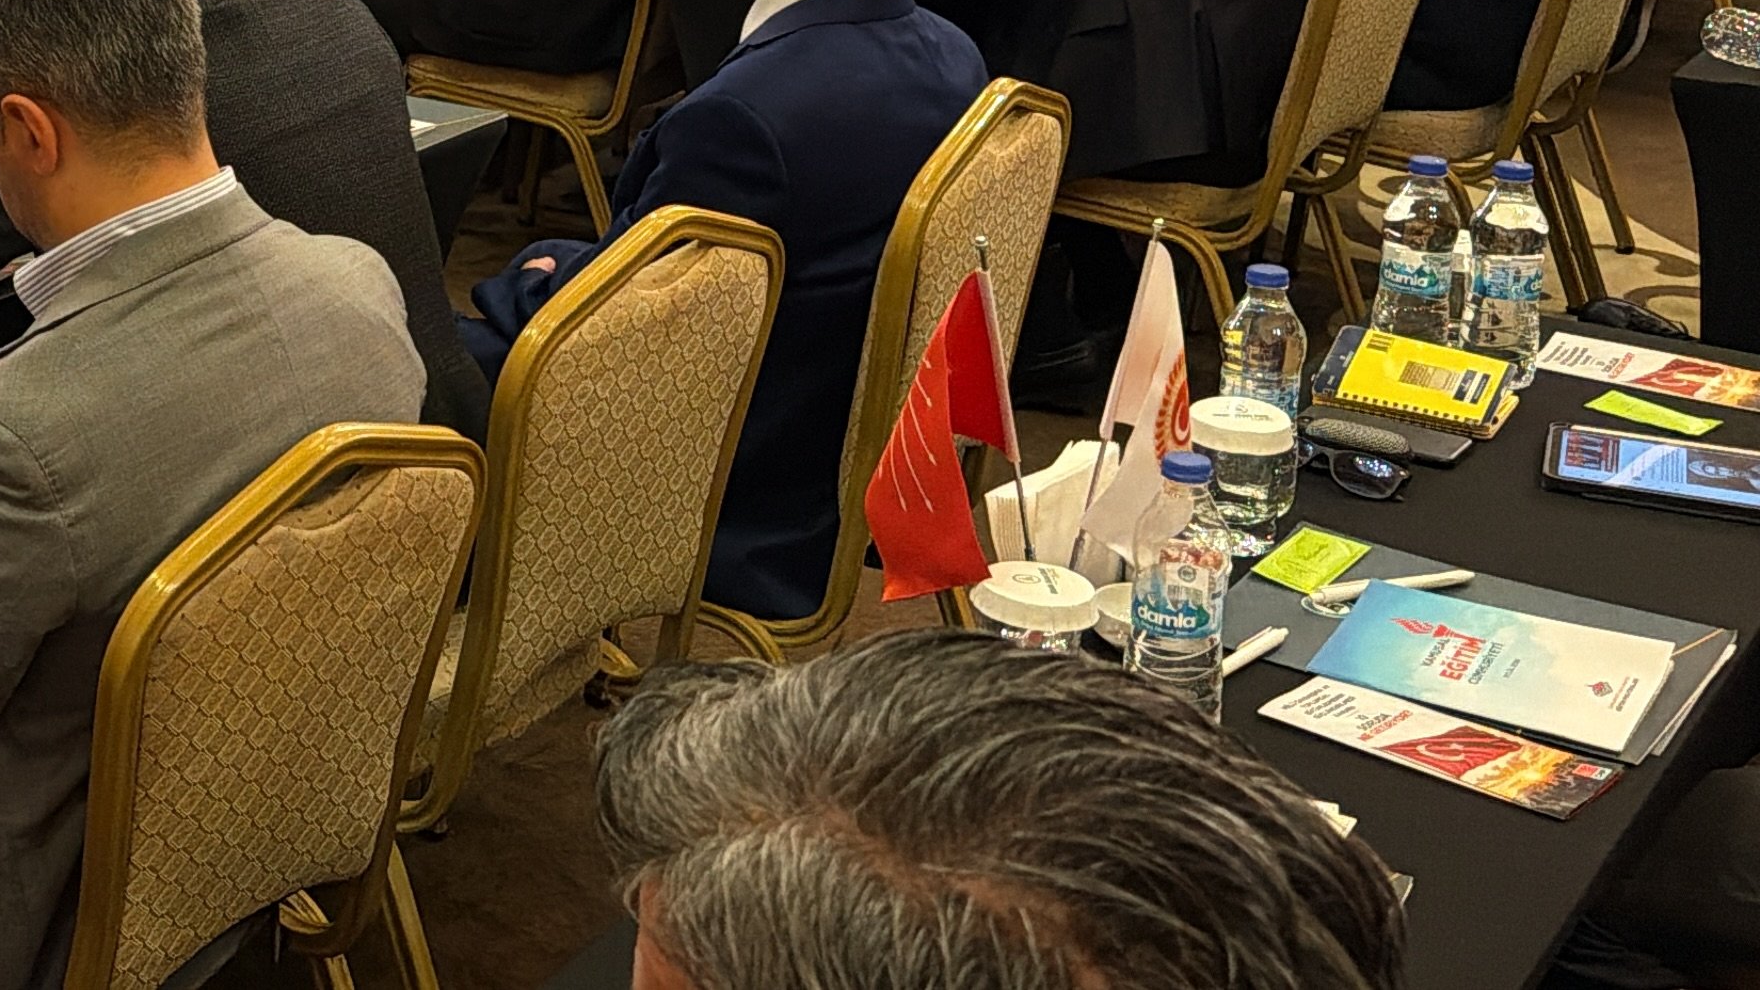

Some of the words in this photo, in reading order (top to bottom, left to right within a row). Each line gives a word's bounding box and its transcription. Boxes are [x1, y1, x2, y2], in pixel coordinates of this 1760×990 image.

[1383, 267, 1429, 288] damla
[1137, 604, 1197, 629] damla
[1439, 636, 1488, 681] EĞİTİM
